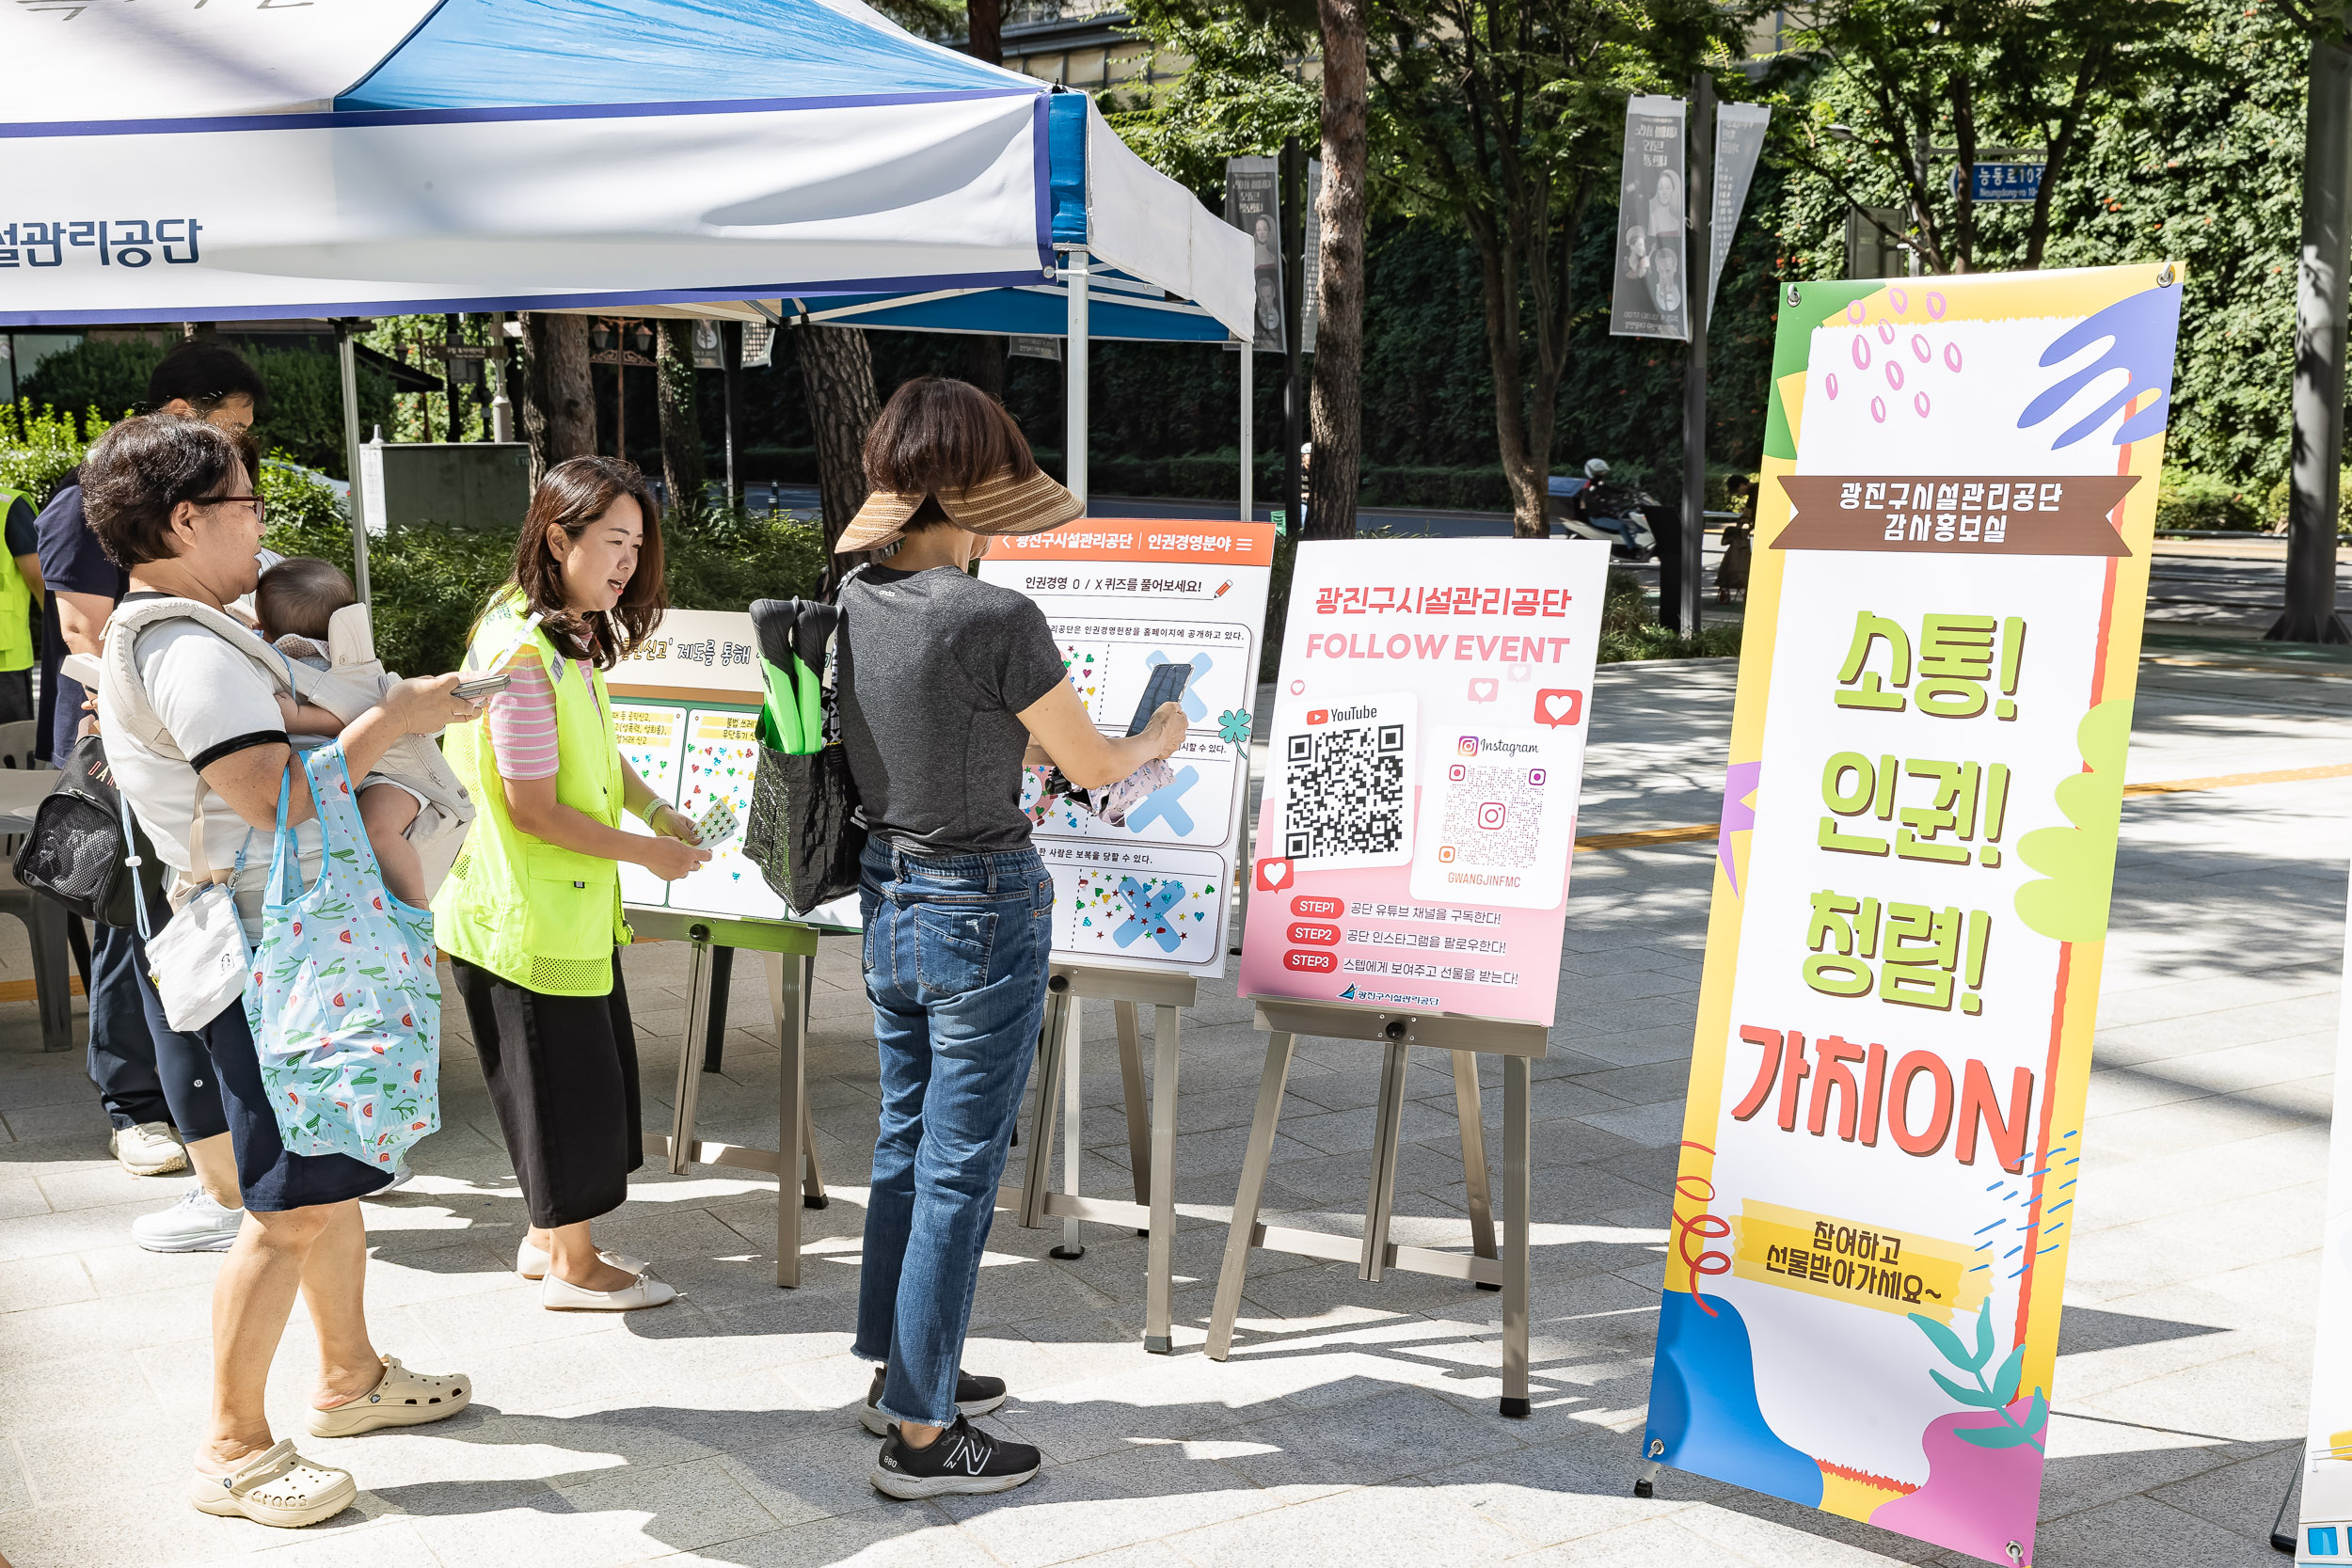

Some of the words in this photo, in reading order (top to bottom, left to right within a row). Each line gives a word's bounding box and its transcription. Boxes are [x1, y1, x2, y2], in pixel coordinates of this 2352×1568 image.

[1839, 482, 2063, 512] 광진구시설관리공단
[1883, 514, 2008, 544] 감사홍보실
[1016, 532, 1134, 549] 광진구시설관리공단
[1148, 533, 1232, 552] 인권경영분야
[1025, 577, 1068, 590] 인권경영
[1104, 578, 1138, 592] 퀴즈를
[1140, 578, 1202, 593] 풀어보세요!
[1316, 587, 1572, 617] 광진구시설관리공단
[1085, 626, 1140, 637] 인권경영헌장을
[1144, 627, 1184, 639] 홈페이지에
[1188, 629, 1221, 640] 공개하고
[1225, 631, 1244, 641] 있다.
[677, 640, 715, 666] 제도를
[721, 641, 751, 664] 통해
[1306, 633, 1450, 659] FOLLOW
[1454, 634, 1570, 663] EVENT
[1835, 610, 2026, 721] 소통!
[727, 717, 739, 728] 불법
[1331, 705, 1377, 722] YouTube
[723, 730, 748, 740] 무단투기
[1480, 738, 1539, 757] Instagram
[1199, 743, 1206, 752] 수
[1209, 744, 1226, 753] 있다.
[1818, 751, 2010, 868] 인권!
[1049, 848, 1073, 858] 사람은
[1076, 850, 1100, 861] 보복을
[1103, 852, 1119, 862] 당할
[1122, 854, 1130, 863] 수
[1133, 855, 1152, 864] 있다.
[1448, 872, 1521, 888] GWANGJINFMC
[1299, 900, 1334, 913] STEP1
[1351, 902, 1373, 914] 공단
[1376, 904, 1409, 917] 유튜브
[1412, 907, 1447, 920] 채널을
[1451, 910, 1502, 925] 구독한다!
[1295, 927, 1332, 941] STEP2
[1348, 929, 1369, 942] 공단
[1374, 931, 1440, 948] 인스타그램을
[1444, 937, 1506, 954] 팔로우한다!
[1802, 889, 1992, 1016] 청렴!
[1292, 954, 1329, 968] STEP3
[1343, 959, 1388, 973] 스텝에게
[1391, 962, 1437, 977] 보여주고
[1441, 967, 1475, 981] 선물을
[1479, 970, 1518, 985] 받는다!
[1358, 990, 1439, 1006] 광진구시설관리공단
[1731, 1024, 2034, 1175] 가치ON
[1813, 1220, 1901, 1266] 참여하고
[1766, 1243, 1942, 1305] 선물받아가세요~
[884, 1455, 898, 1468] 880
[251, 1491, 307, 1507] crocs
